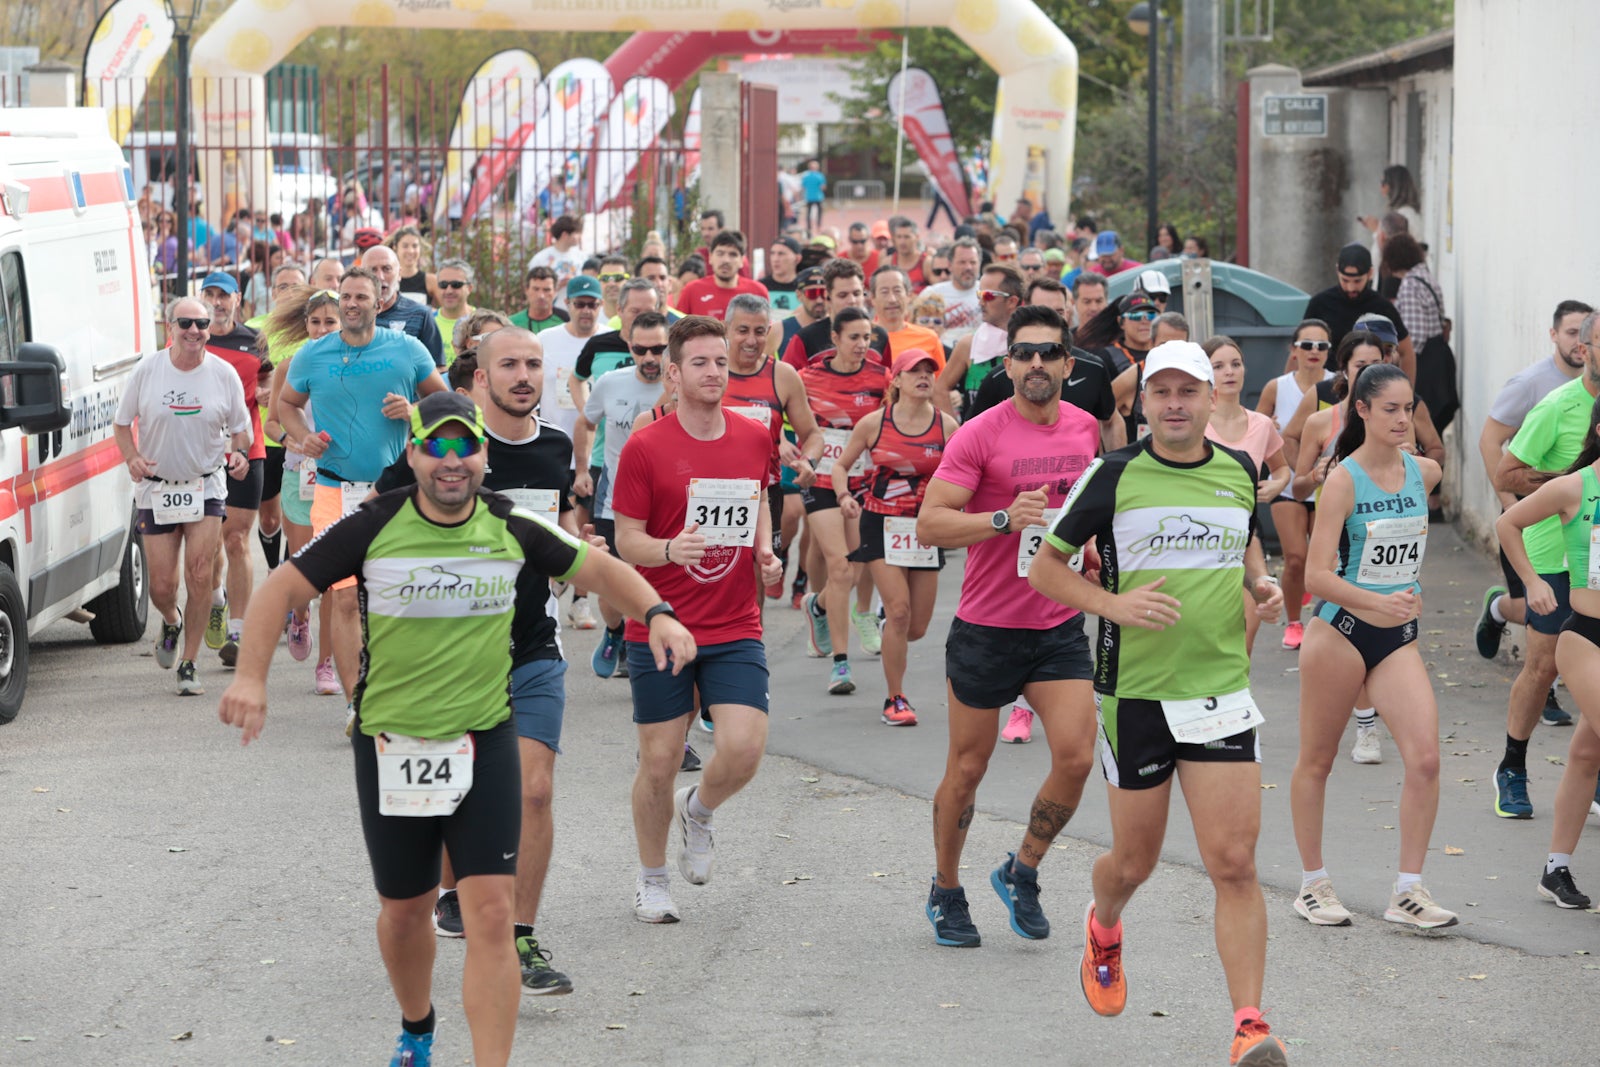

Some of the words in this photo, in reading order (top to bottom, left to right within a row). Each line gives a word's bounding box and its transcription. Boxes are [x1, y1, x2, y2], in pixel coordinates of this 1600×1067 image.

[1284, 99, 1320, 110] CALLE
[328, 358, 395, 378] Reebok
[823, 444, 843, 459] 20
[162, 493, 193, 508] 309
[1355, 493, 1417, 514] nerja
[695, 505, 749, 526] 3113
[1370, 541, 1419, 566] 3074
